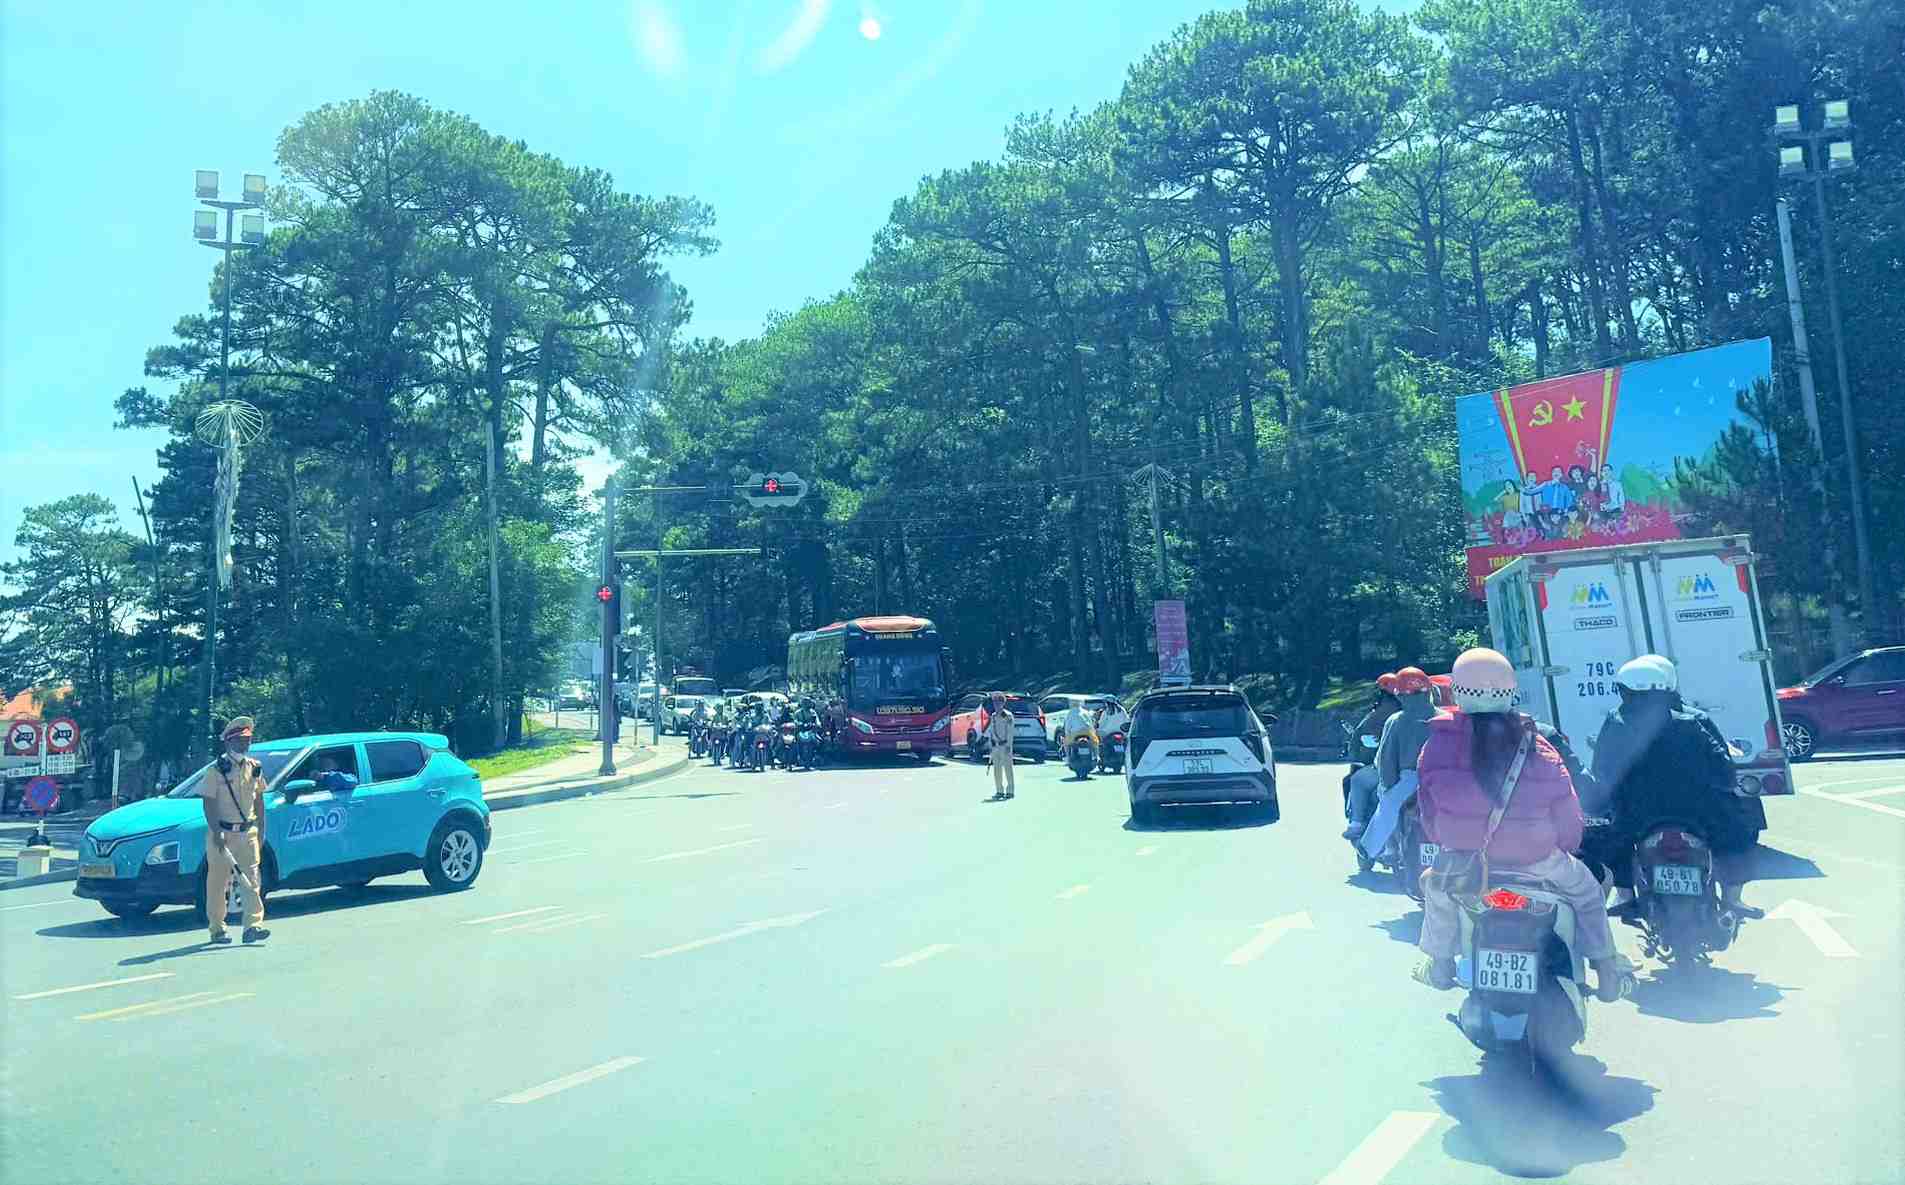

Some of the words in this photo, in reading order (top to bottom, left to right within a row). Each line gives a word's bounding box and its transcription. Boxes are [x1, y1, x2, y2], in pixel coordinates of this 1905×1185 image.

[1579, 618, 1614, 628] THACO
[1679, 609, 1730, 620] FRONTIER
[1585, 661, 1615, 678] 79C
[287, 812, 340, 838] LADO
[1486, 952, 1527, 971] 49-B2
[1480, 969, 1532, 990] 081.81
